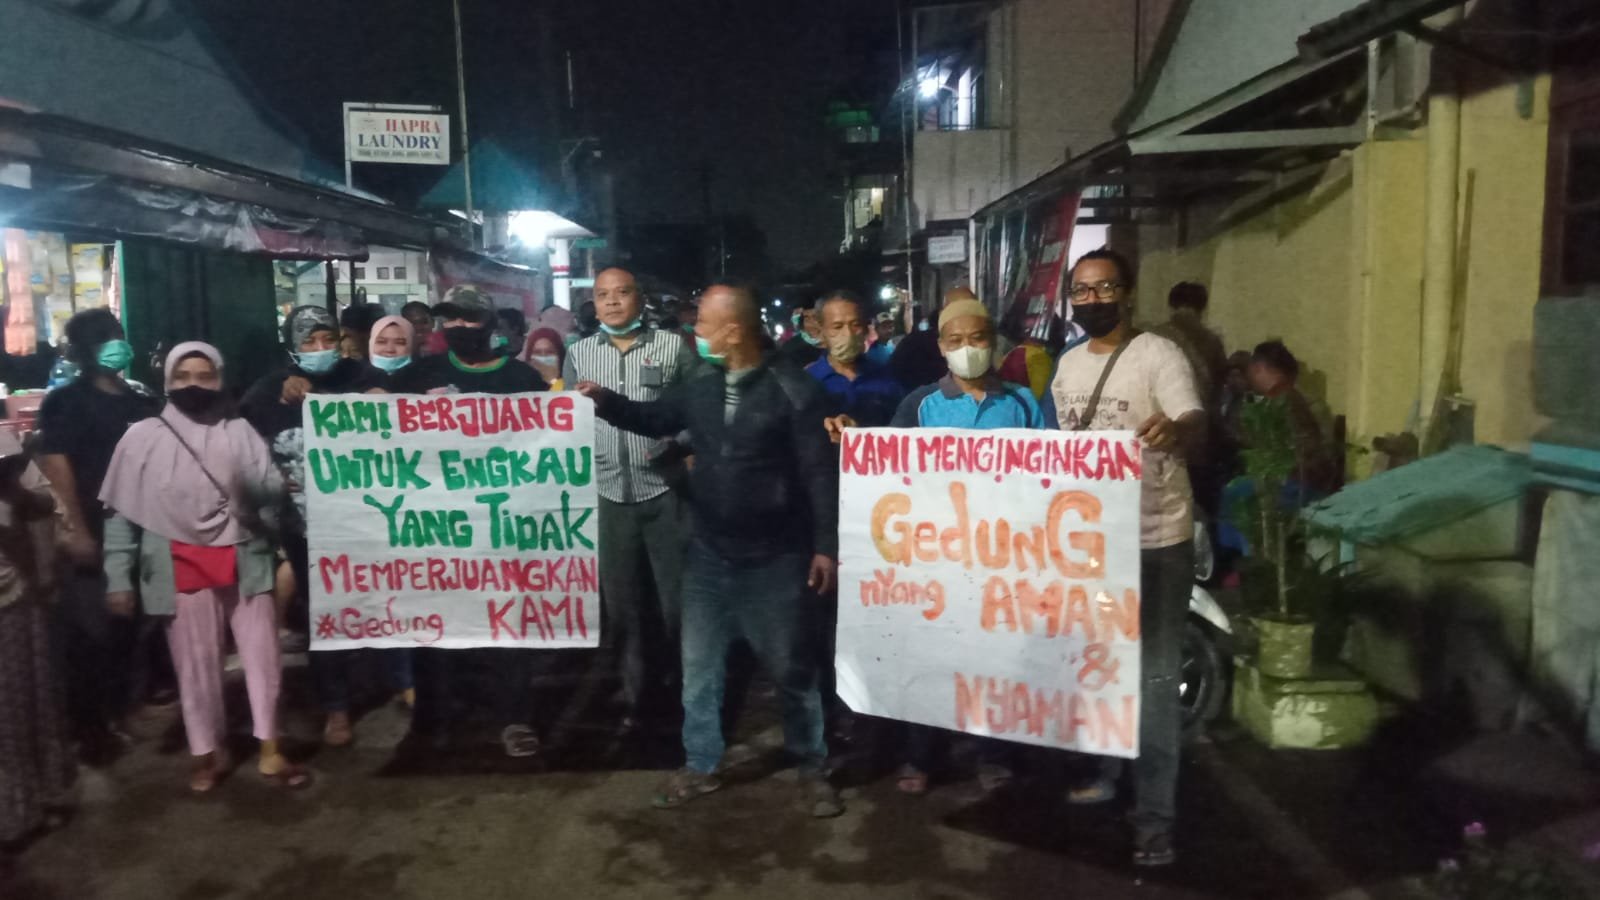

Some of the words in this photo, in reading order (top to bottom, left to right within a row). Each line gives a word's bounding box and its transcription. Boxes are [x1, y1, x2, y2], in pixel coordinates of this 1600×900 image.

[358, 134, 441, 149] LAUNDRY
[385, 119, 441, 133] HAPRA
[397, 396, 574, 437] BERJUANG
[308, 448, 431, 494] UNTUK
[439, 446, 591, 490] ENGKAU
[363, 494, 473, 548] YANG
[318, 554, 599, 593] MEMPERJUANGKAN
[487, 595, 588, 640] KAMI
[980, 576, 1140, 641] AMAN
[1077, 643, 1119, 691] &
[953, 671, 1137, 750] NYAMAN
